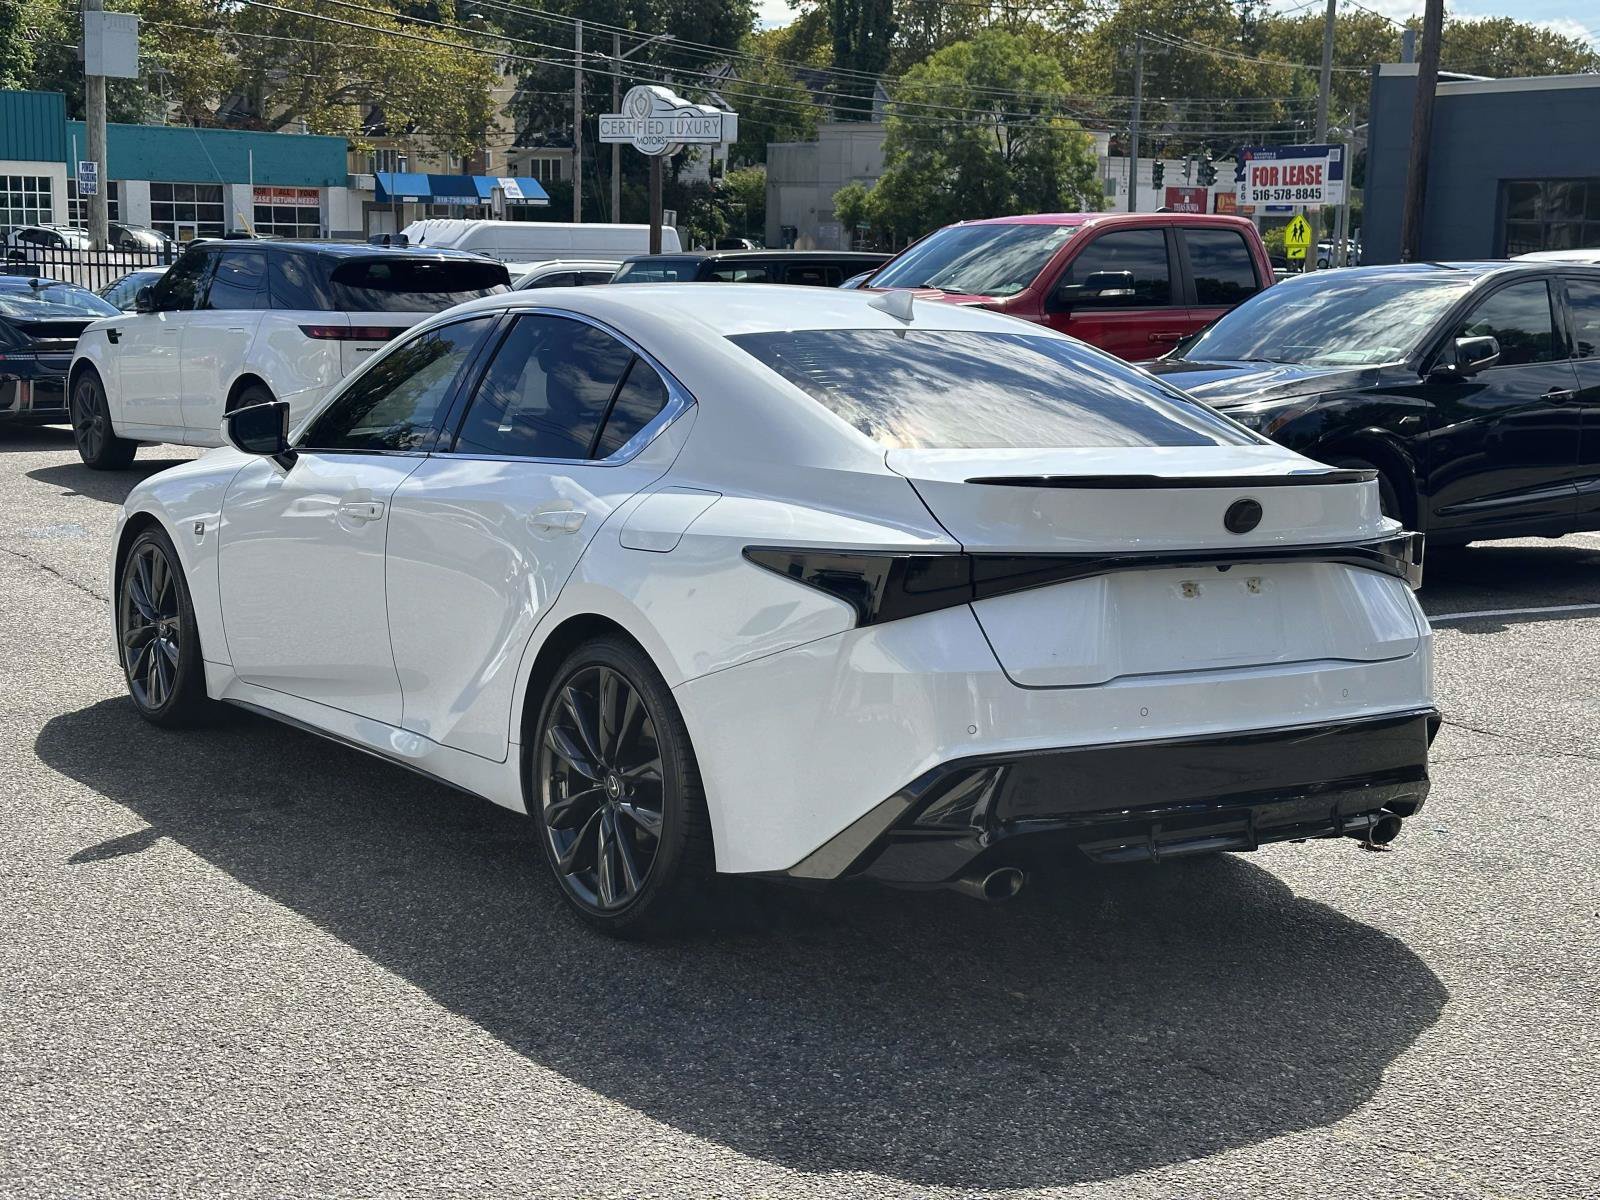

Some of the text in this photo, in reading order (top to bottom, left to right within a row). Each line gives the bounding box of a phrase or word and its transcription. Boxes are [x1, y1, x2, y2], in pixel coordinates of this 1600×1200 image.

[600, 120, 720, 134] CERTIFIED LUXURY
[636, 136, 666, 146] MOTORS
[1252, 164, 1322, 186] FOR LEASE
[1252, 188, 1322, 200] 516-578-8845
